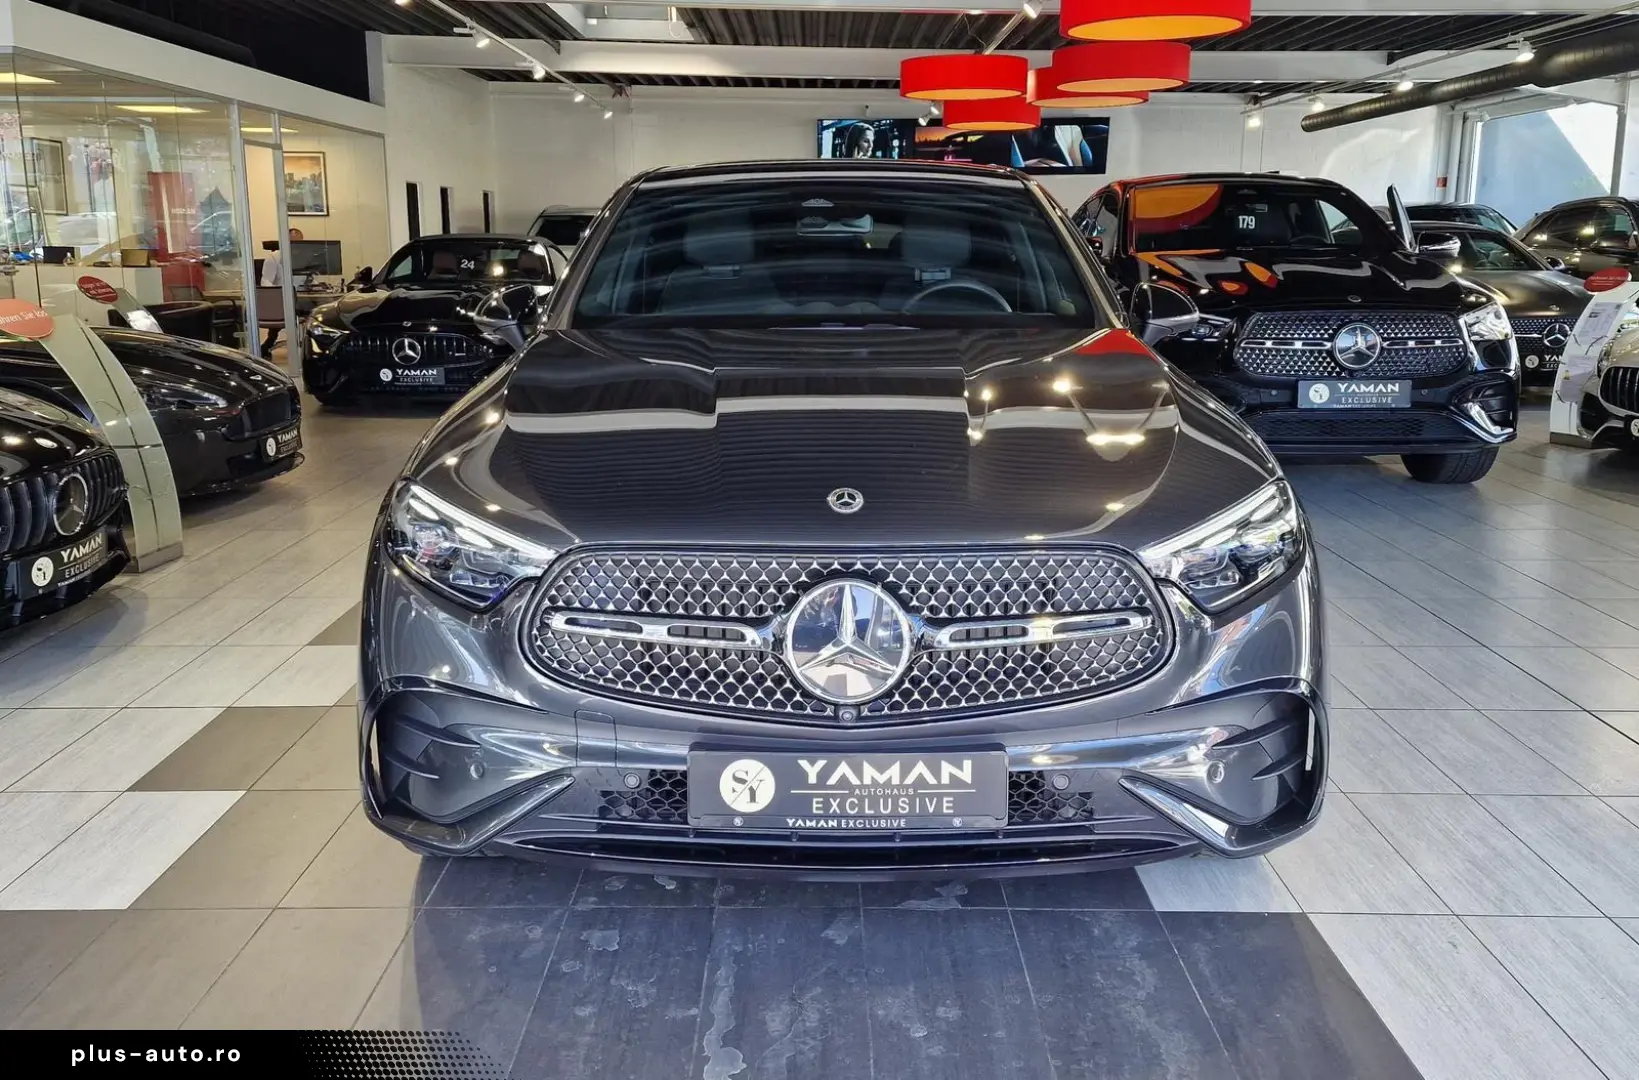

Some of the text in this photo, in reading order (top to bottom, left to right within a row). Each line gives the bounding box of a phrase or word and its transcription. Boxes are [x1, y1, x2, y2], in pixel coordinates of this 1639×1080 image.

[1238, 215, 1255, 229] 179
[460, 259, 475, 269] 24
[396, 368, 437, 376] YAMAN
[1337, 383, 1400, 393] YAMAN
[277, 428, 298, 443] YAMAN
[60, 533, 102, 562] YAMAN
[64, 553, 100, 578] EXCLUSIVE
[797, 759, 972, 785] YAMAN
[854, 788, 915, 796] AUTOHAUS
[812, 797, 955, 814] EXCLUSIVE
[786, 818, 907, 828] YAMAN EXCLUSIVE
